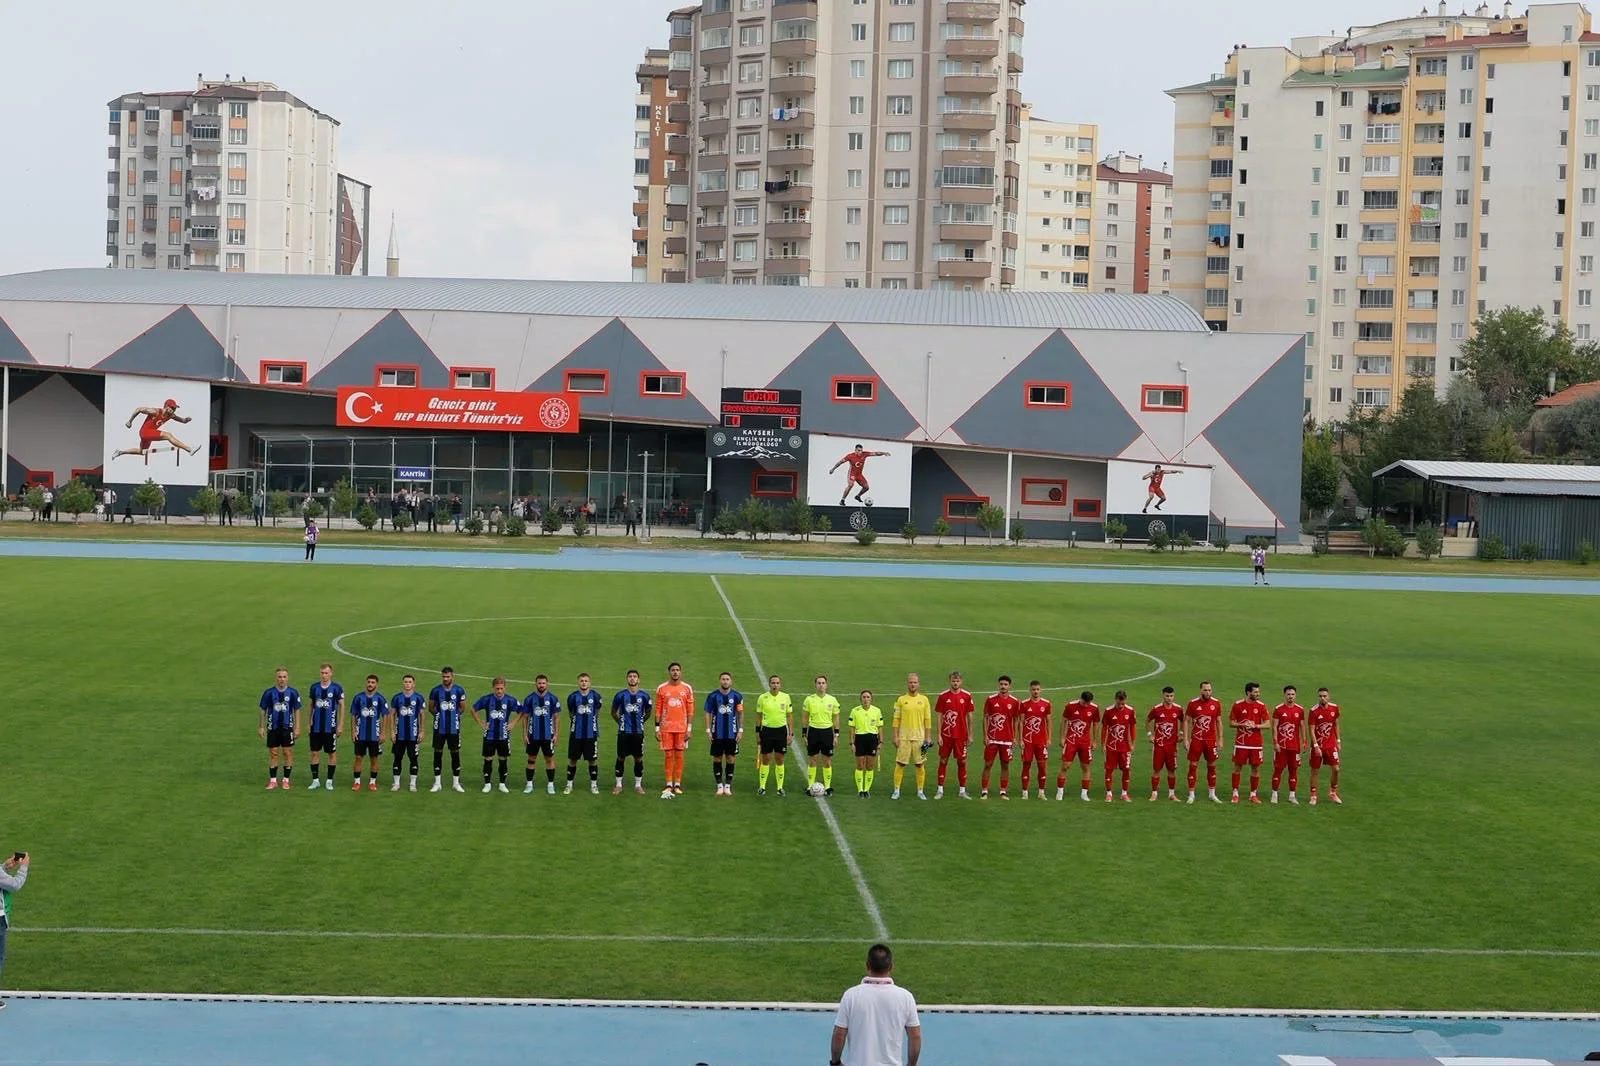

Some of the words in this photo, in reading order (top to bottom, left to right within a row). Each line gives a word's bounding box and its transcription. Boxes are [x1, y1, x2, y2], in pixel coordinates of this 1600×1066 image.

[394, 412, 414, 421] HEP
[416, 411, 460, 422] BİRLİKTE
[462, 411, 523, 424] TÜRKİYE'YİZ
